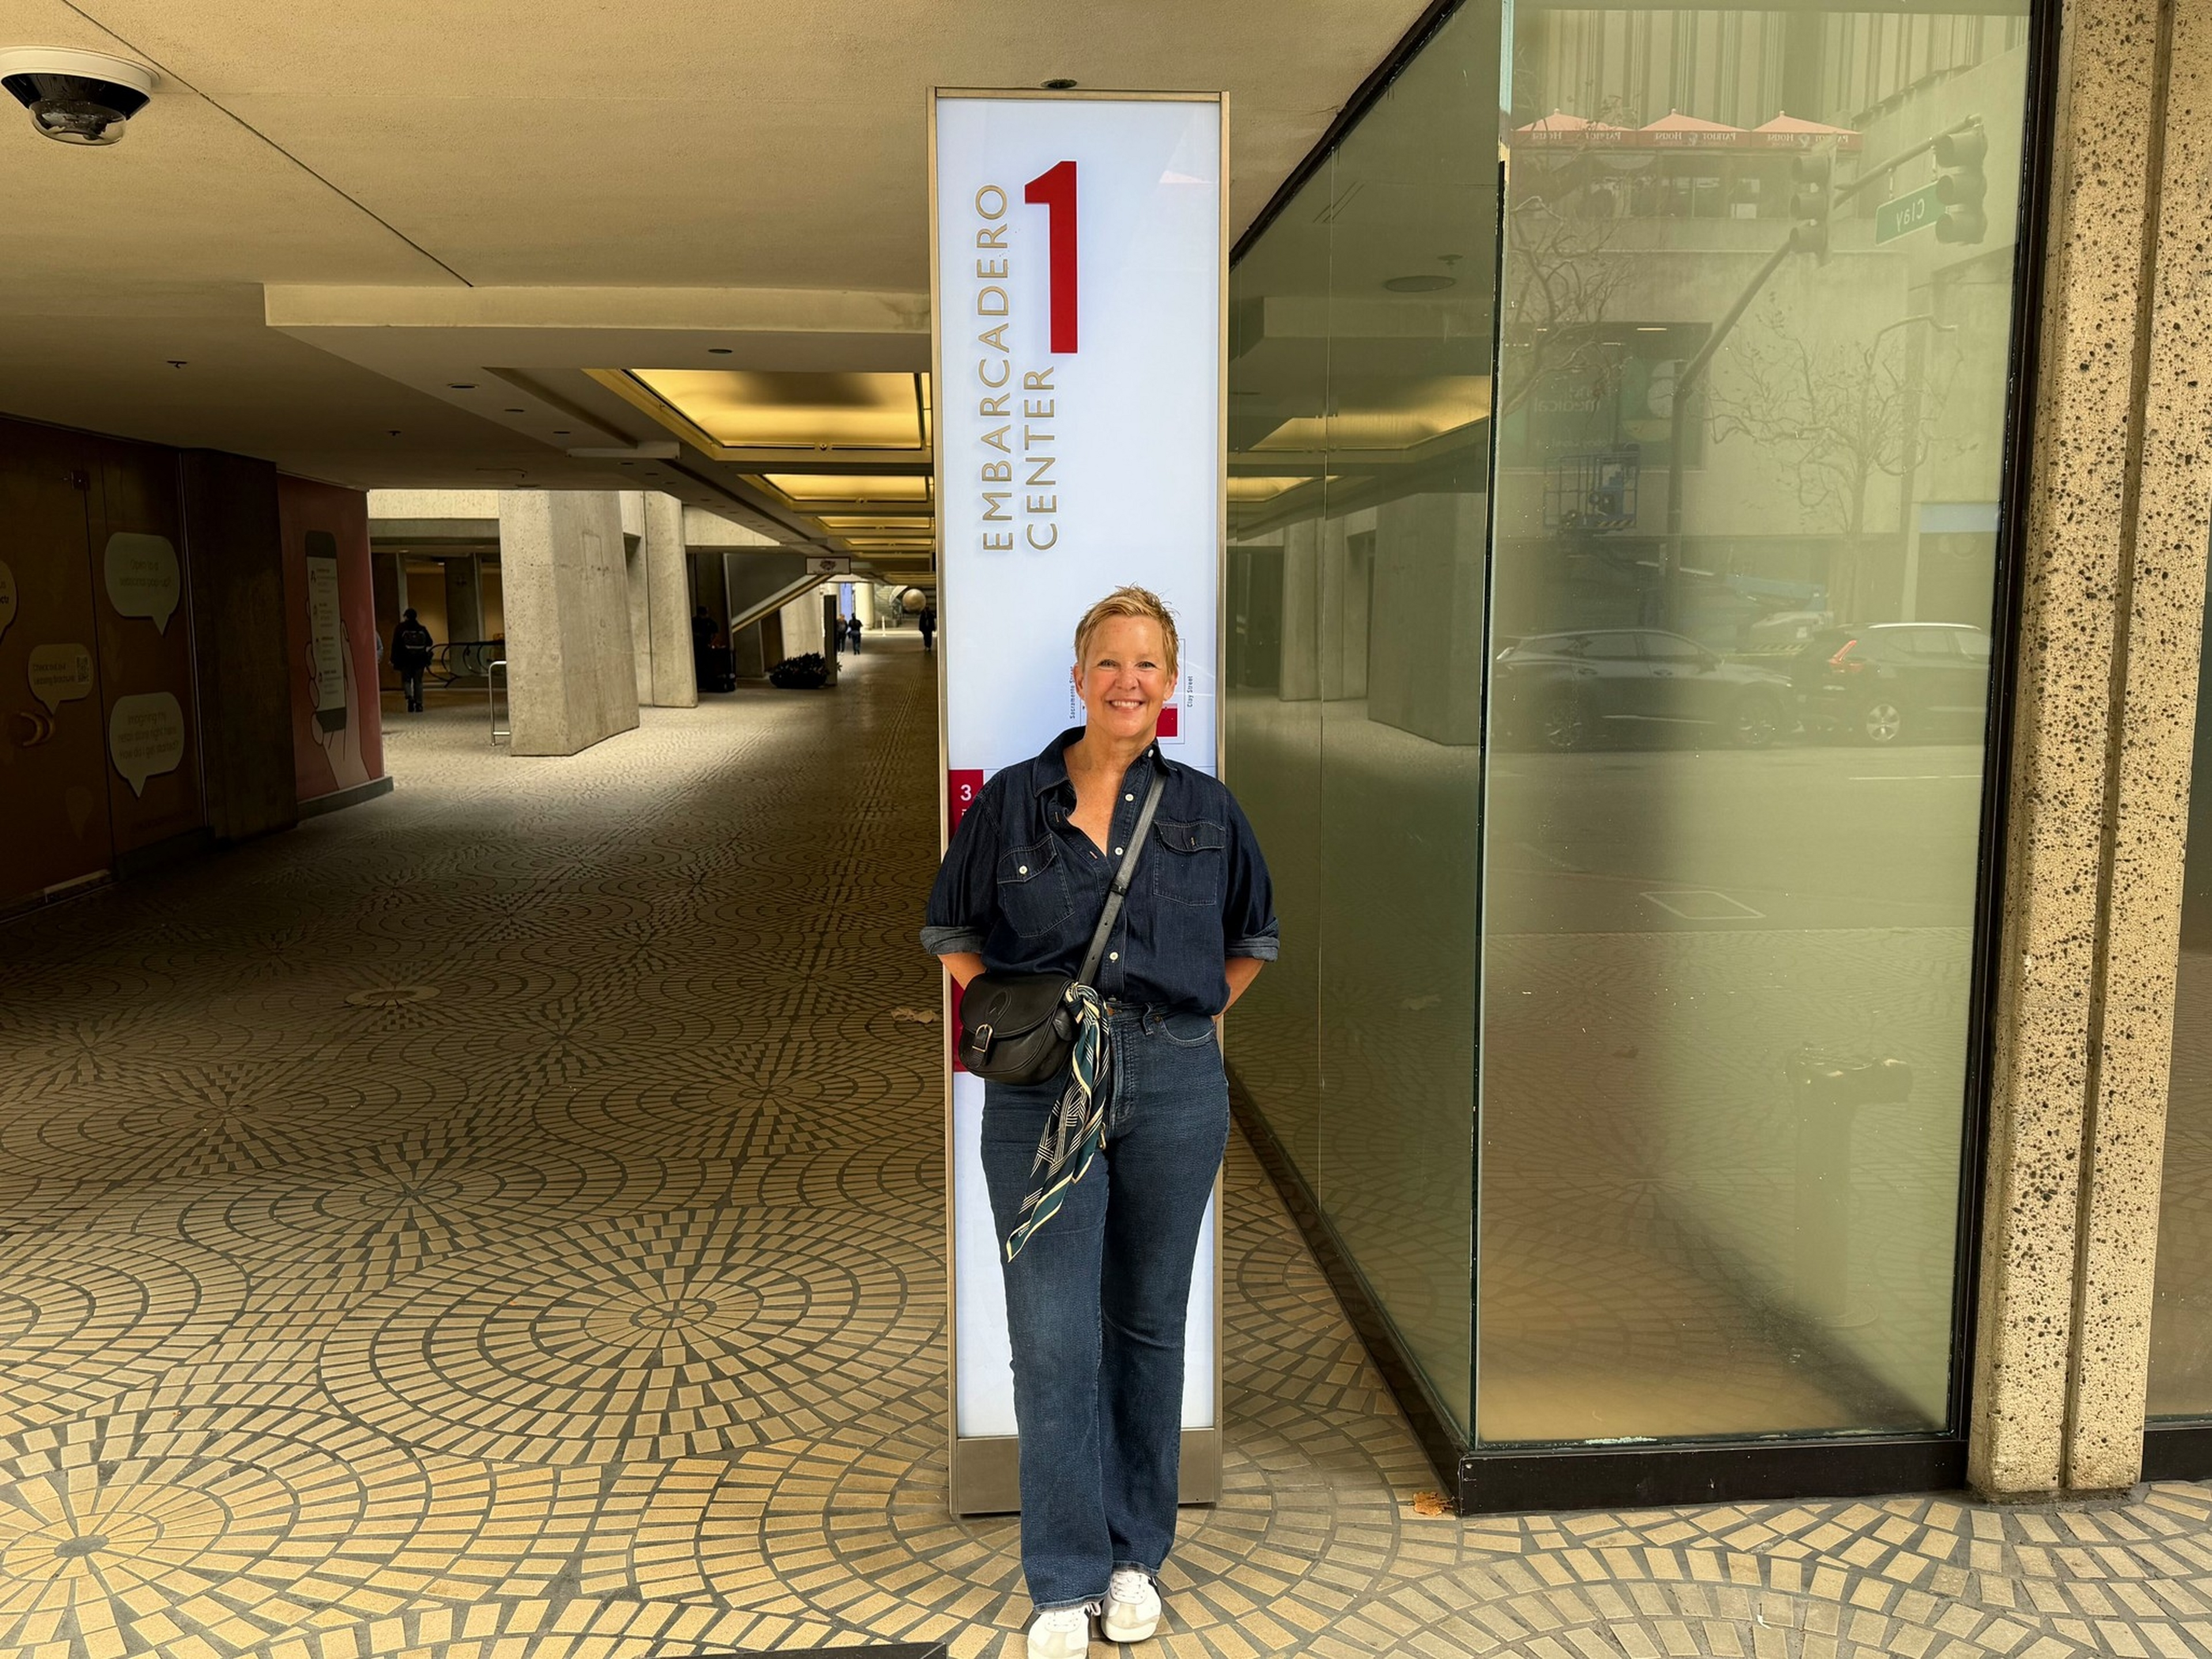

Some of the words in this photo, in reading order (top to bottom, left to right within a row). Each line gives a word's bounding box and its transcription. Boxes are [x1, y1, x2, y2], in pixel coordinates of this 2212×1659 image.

[1024, 160, 1078, 354] 1
[974, 184, 1014, 551] EMBARCADERO
[1023, 366, 1058, 551] CENTER
[961, 784, 971, 801] 3
